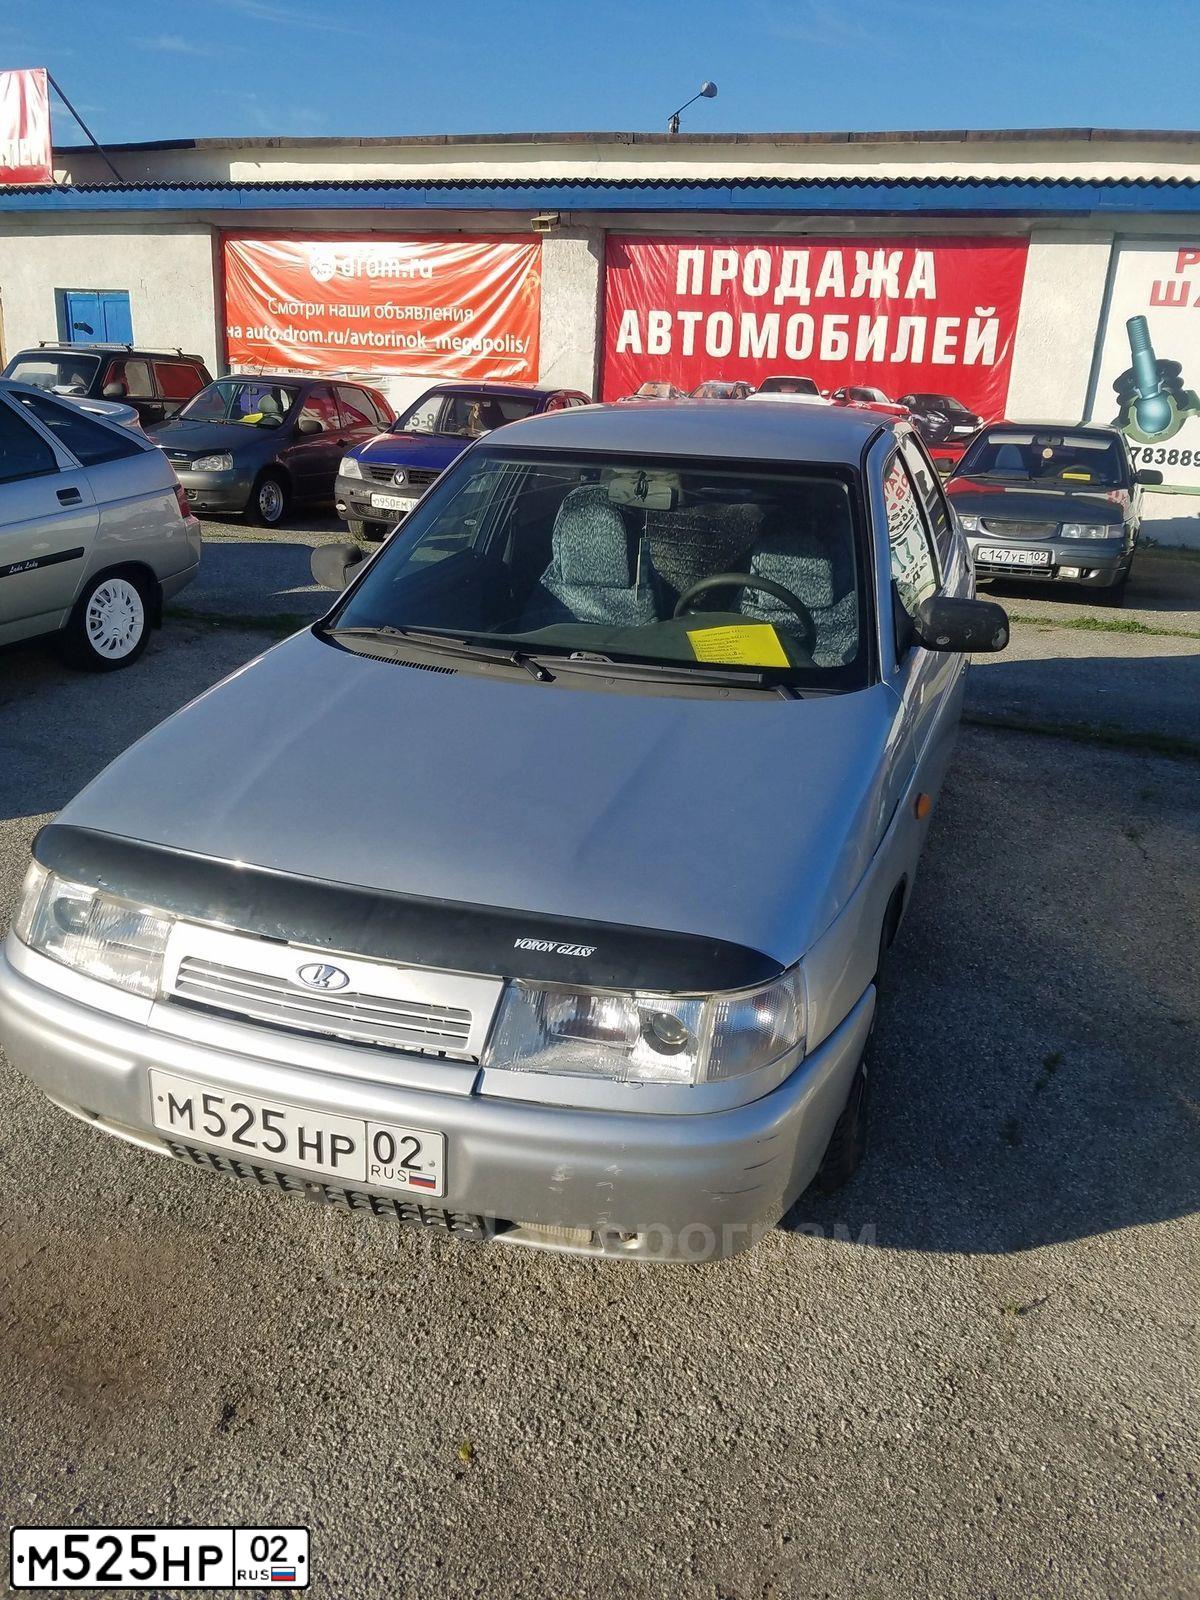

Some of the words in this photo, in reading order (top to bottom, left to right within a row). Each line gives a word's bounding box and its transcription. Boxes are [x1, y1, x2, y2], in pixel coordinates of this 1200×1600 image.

[341, 250, 434, 279] drom.ru
[676, 249, 937, 305] ПРОДАЖА
[1149, 280, 1200, 307] Ш
[268, 297, 325, 319] Смотри
[329, 304, 370, 318] наши
[374, 302, 475, 322] объявления
[246, 324, 531, 355] auto.drom.ru/avtorinok_megapolis/
[616, 306, 999, 366] АВТОМОБИЛЕЙ
[980, 550, 1025, 562] С147УЕ
[1029, 552, 1046, 561] 102
[514, 938, 558, 952] VORON
[557, 943, 595, 957] GLASS
[168, 1092, 355, 1168] М525НР
[373, 1130, 423, 1170] 02
[371, 1164, 407, 1182] RUS
